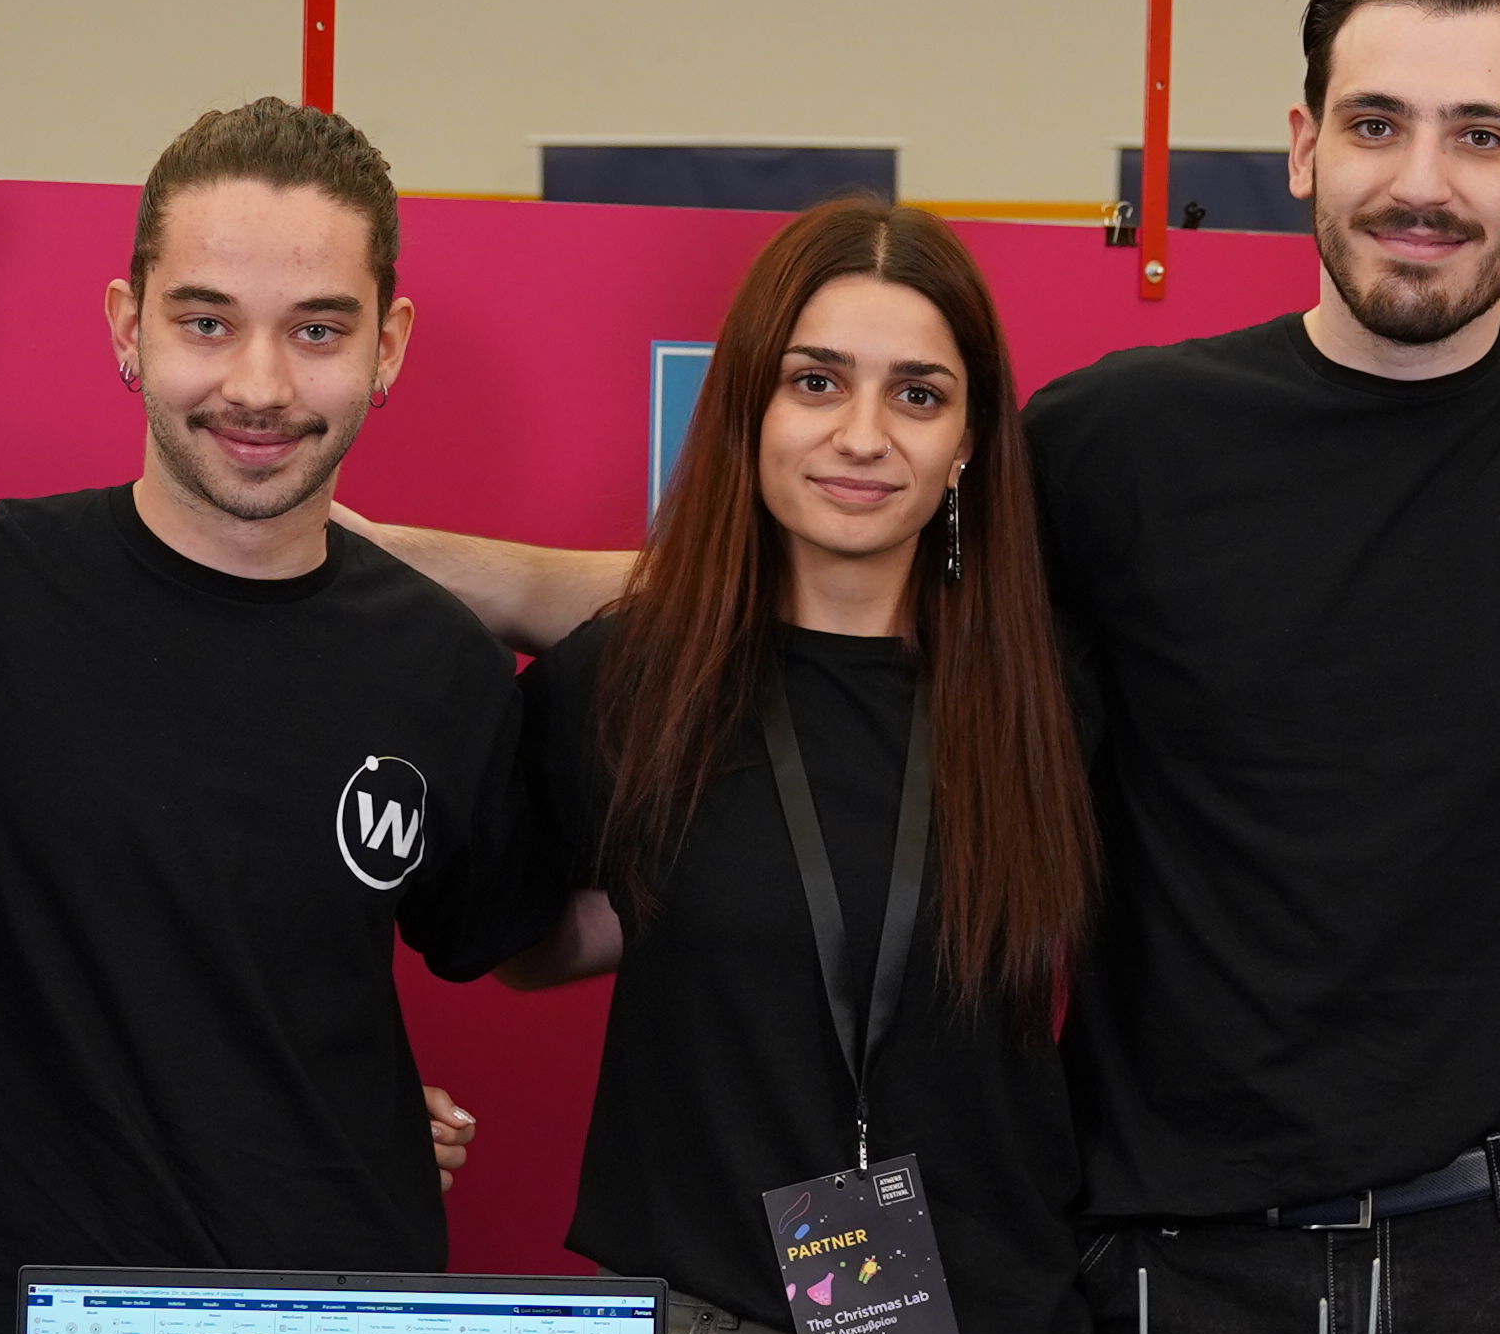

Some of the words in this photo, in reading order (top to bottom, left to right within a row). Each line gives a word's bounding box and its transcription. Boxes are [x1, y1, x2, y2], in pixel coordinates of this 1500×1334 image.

[881, 1182, 904, 1194] SCIENCE
[882, 1188, 909, 1200] FESTIVAL
[786, 1229, 868, 1261] PARTNER
[806, 1317, 833, 1333] The
[834, 1297, 902, 1325] Christmas
[904, 1290, 930, 1308] Lab
